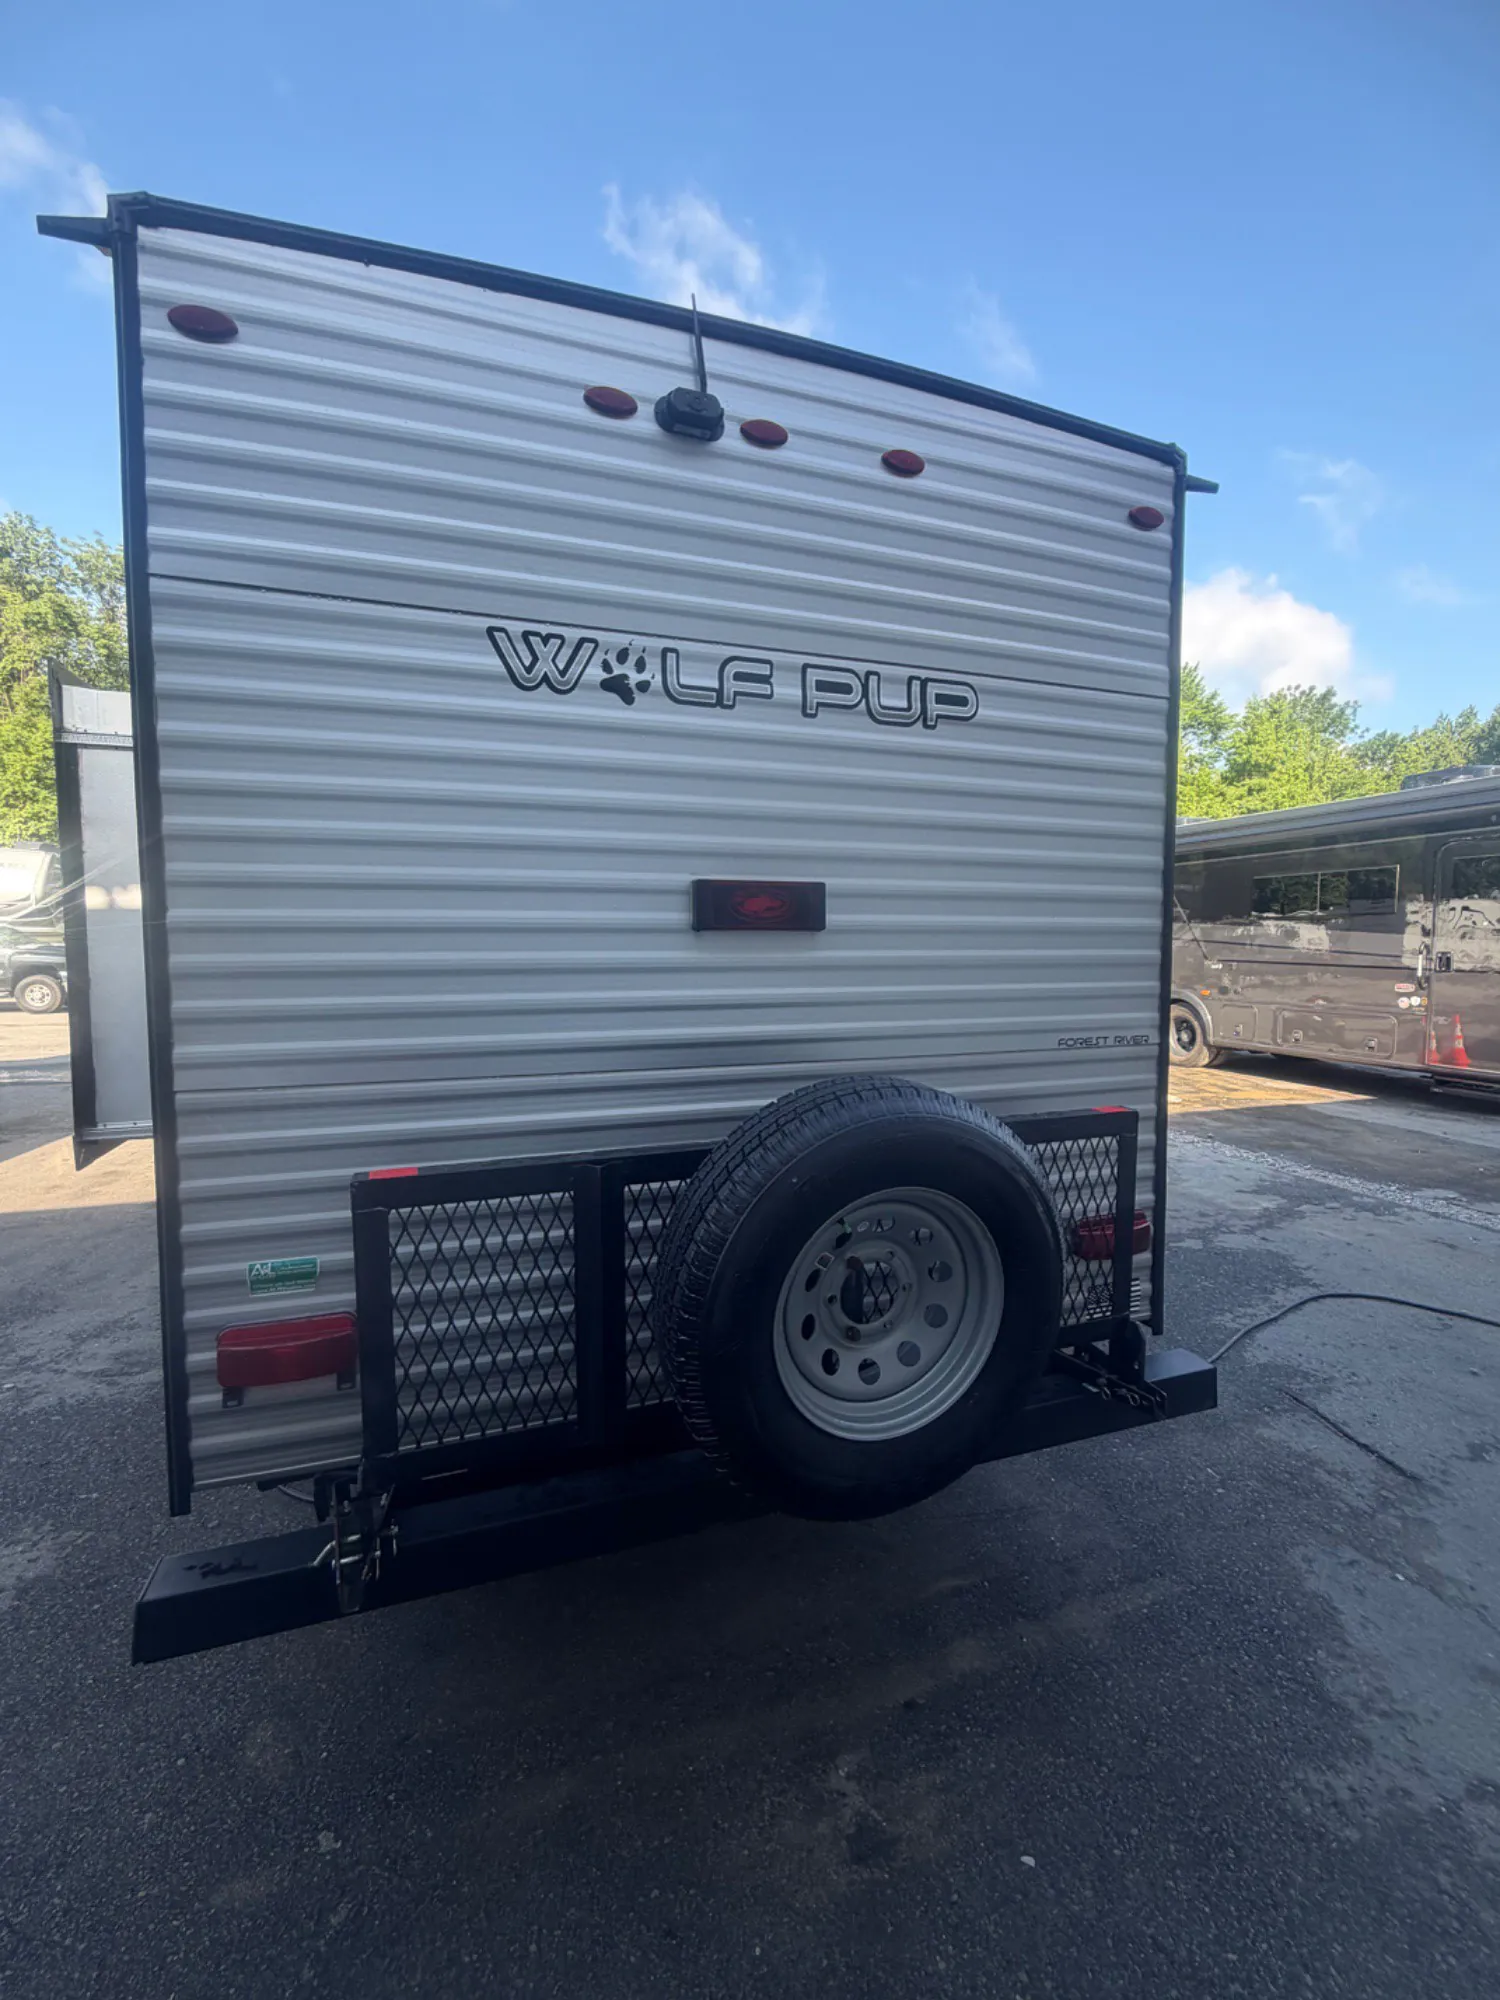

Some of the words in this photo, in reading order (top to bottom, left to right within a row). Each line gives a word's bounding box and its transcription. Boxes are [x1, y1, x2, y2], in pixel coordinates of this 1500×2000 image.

[802, 663, 979, 730] PUP
[1058, 1036, 1109, 1048] FOREST
[1113, 1035, 1149, 1045] RIVER
